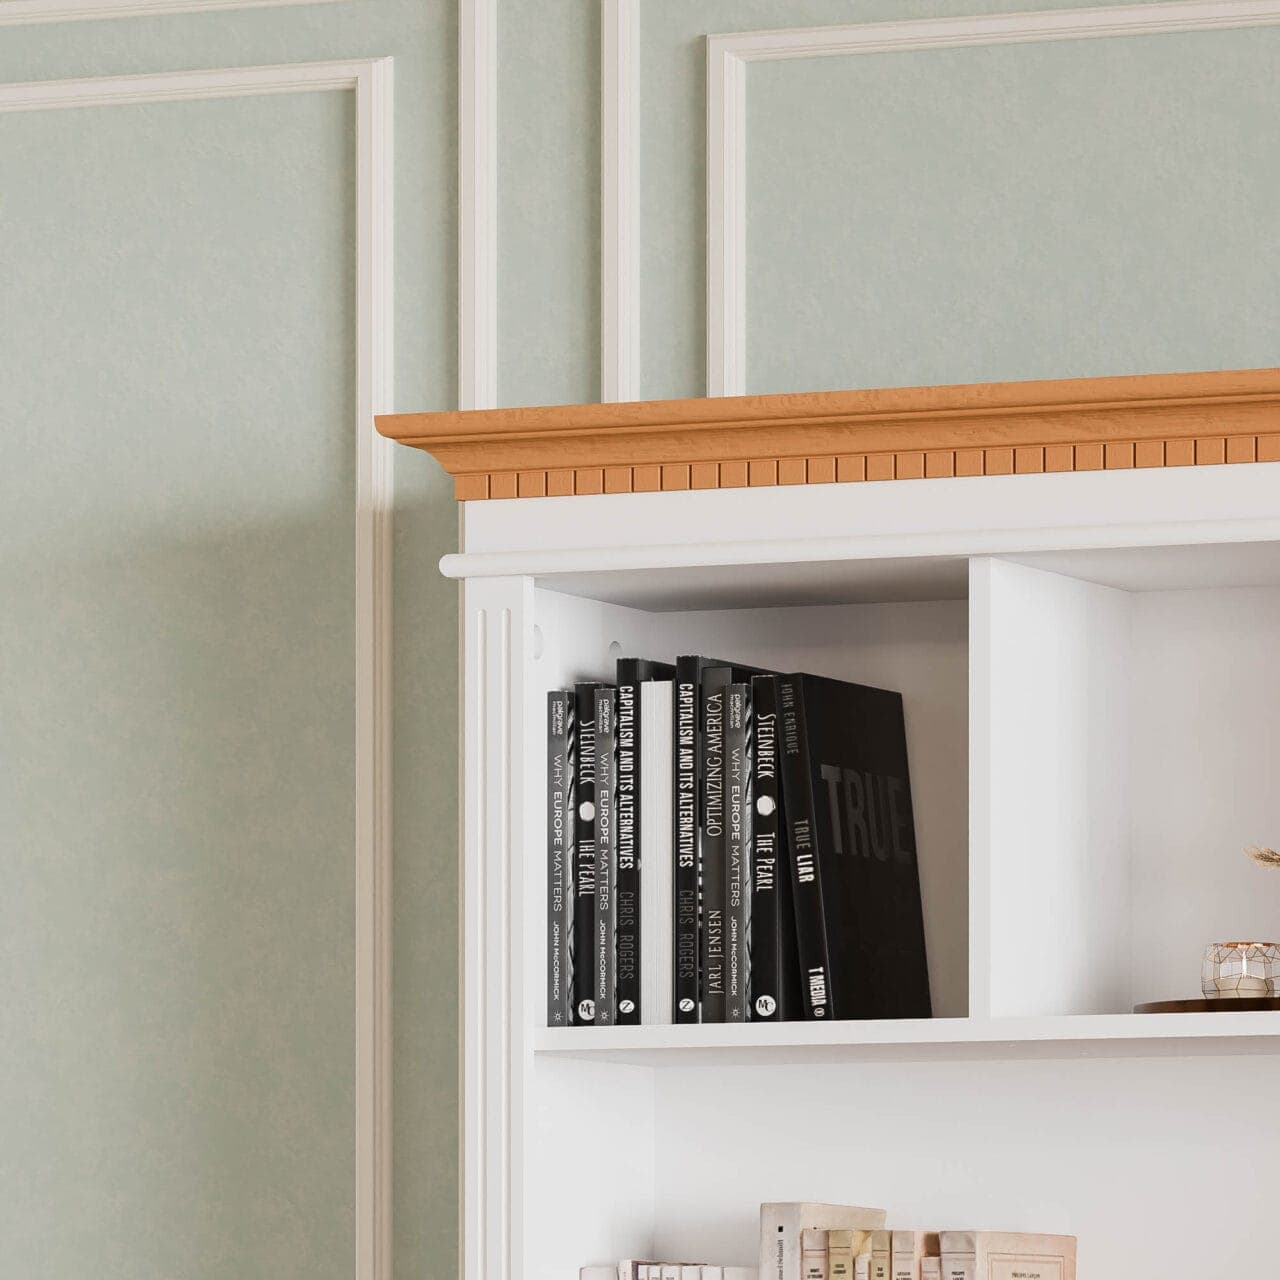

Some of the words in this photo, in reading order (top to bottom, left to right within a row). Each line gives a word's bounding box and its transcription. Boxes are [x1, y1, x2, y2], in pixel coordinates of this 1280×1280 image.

[556, 701, 565, 735] palgrave
[602, 699, 611, 733] palgrave
[619, 685, 634, 747] CAPITALISM
[679, 683, 694, 745] CAPITALISM
[706, 693, 722, 754] AMERICA
[733, 694, 742, 729] palgrave
[553, 754, 563, 787] WHY
[600, 752, 609, 786] WHY
[619, 750, 634, 772] AND
[679, 748, 694, 769] AND
[731, 748, 740, 781] WHY
[619, 775, 634, 791] ITS
[679, 772, 694, 789] ITS
[706, 757, 722, 836] OPTIMIZING
[553, 791, 563, 846] EUROPE
[600, 790, 609, 844] EUROPE
[679, 792, 694, 868] ALTERNATIVES
[731, 785, 740, 840] EUROPE
[820, 764, 914, 865] TRUE
[619, 794, 634, 870] ALTERNATIVES
[793, 820, 811, 849] TRUE
[553, 850, 563, 912] MATTERS
[578, 863, 595, 897] PEARL
[600, 849, 609, 911] MATTERS
[731, 845, 740, 907] MATTERS
[796, 854, 815, 883] LIAR
[619, 891, 634, 926] CHRIS
[679, 890, 694, 924] CHRIS
[708, 910, 724, 958] JENSEN
[730, 916, 738, 941] JOHN
[619, 935, 634, 980] ROGERS
[679, 933, 694, 978] ROGERS
[730, 943, 738, 996] McCORMICK
[708, 965, 724, 994] JARL
[809, 975, 827, 1007] MEDIA
